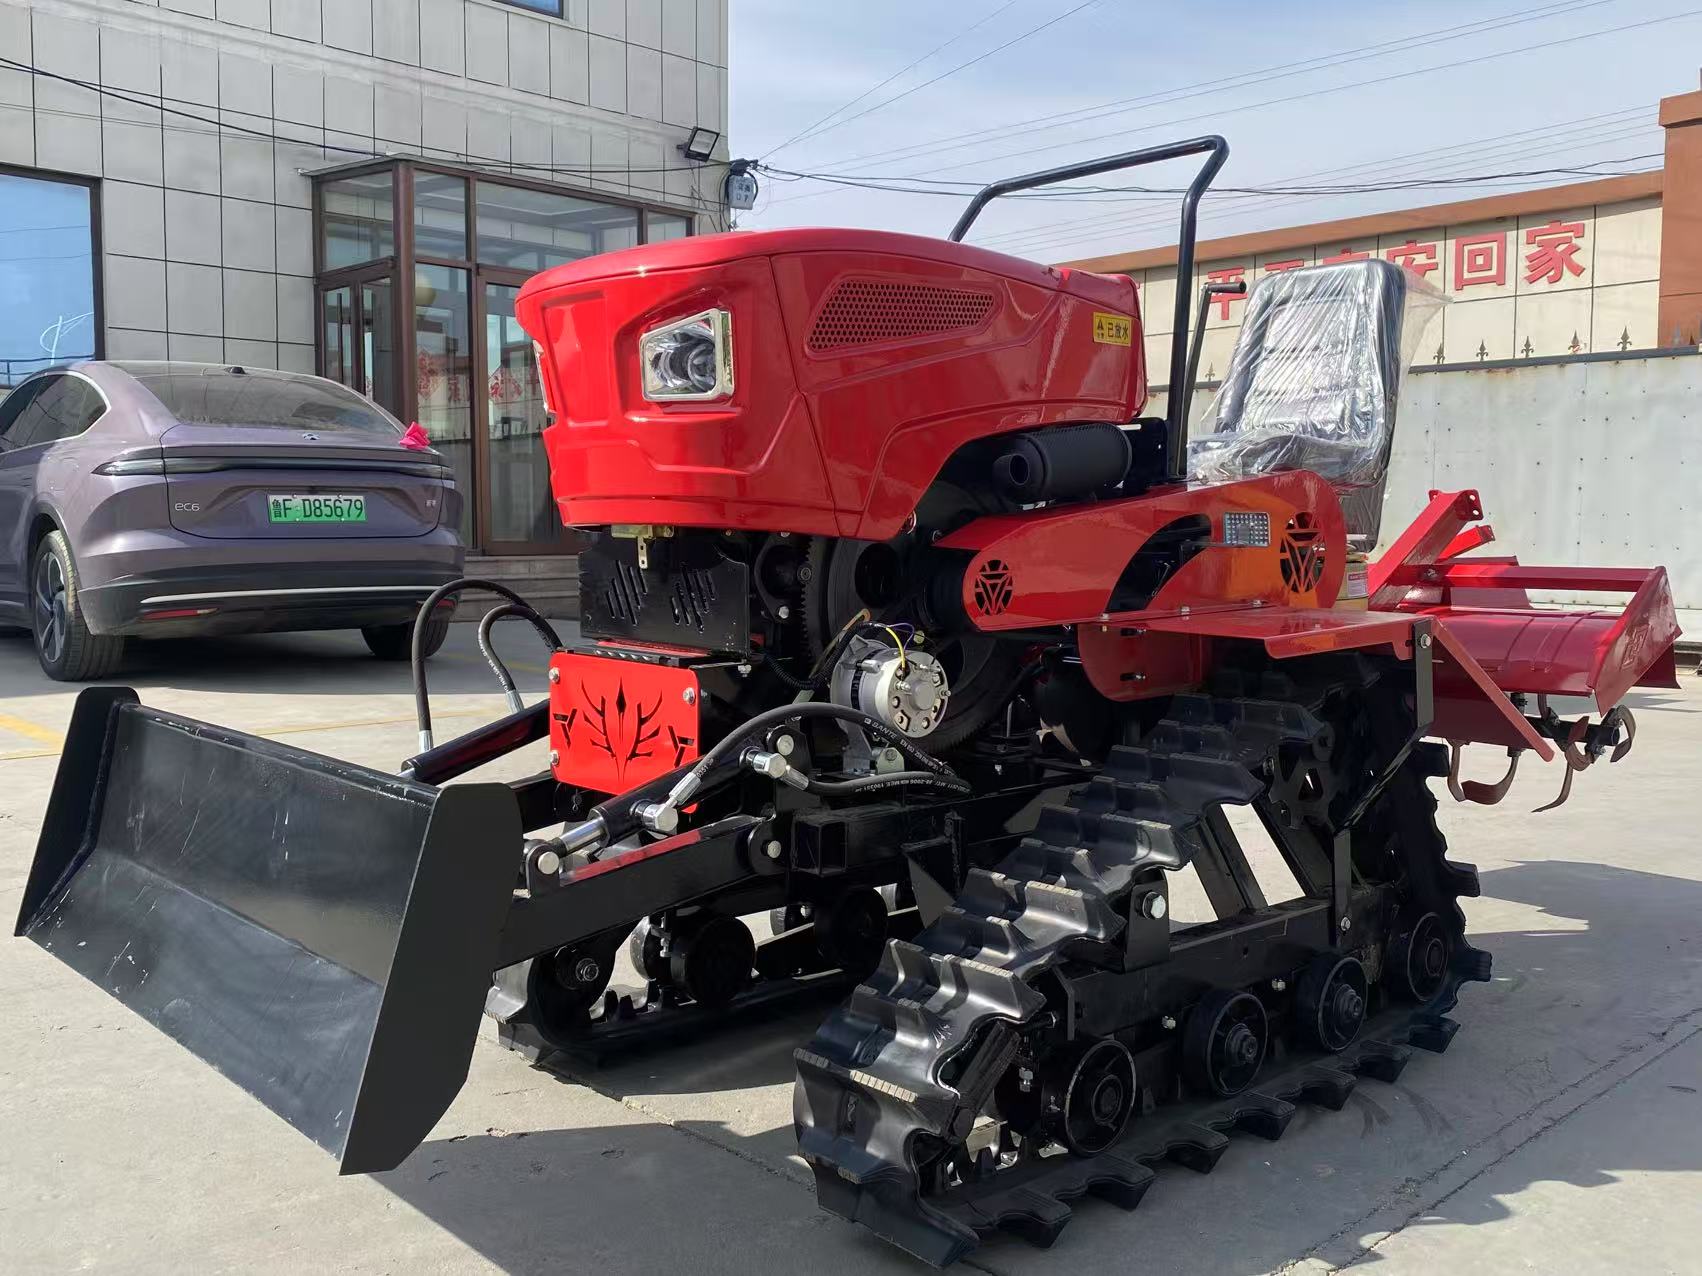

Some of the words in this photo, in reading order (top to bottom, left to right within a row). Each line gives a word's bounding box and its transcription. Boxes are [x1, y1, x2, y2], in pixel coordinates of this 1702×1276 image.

[1207, 219, 1586, 321] 平安回家
[301, 498, 363, 518] D85679
